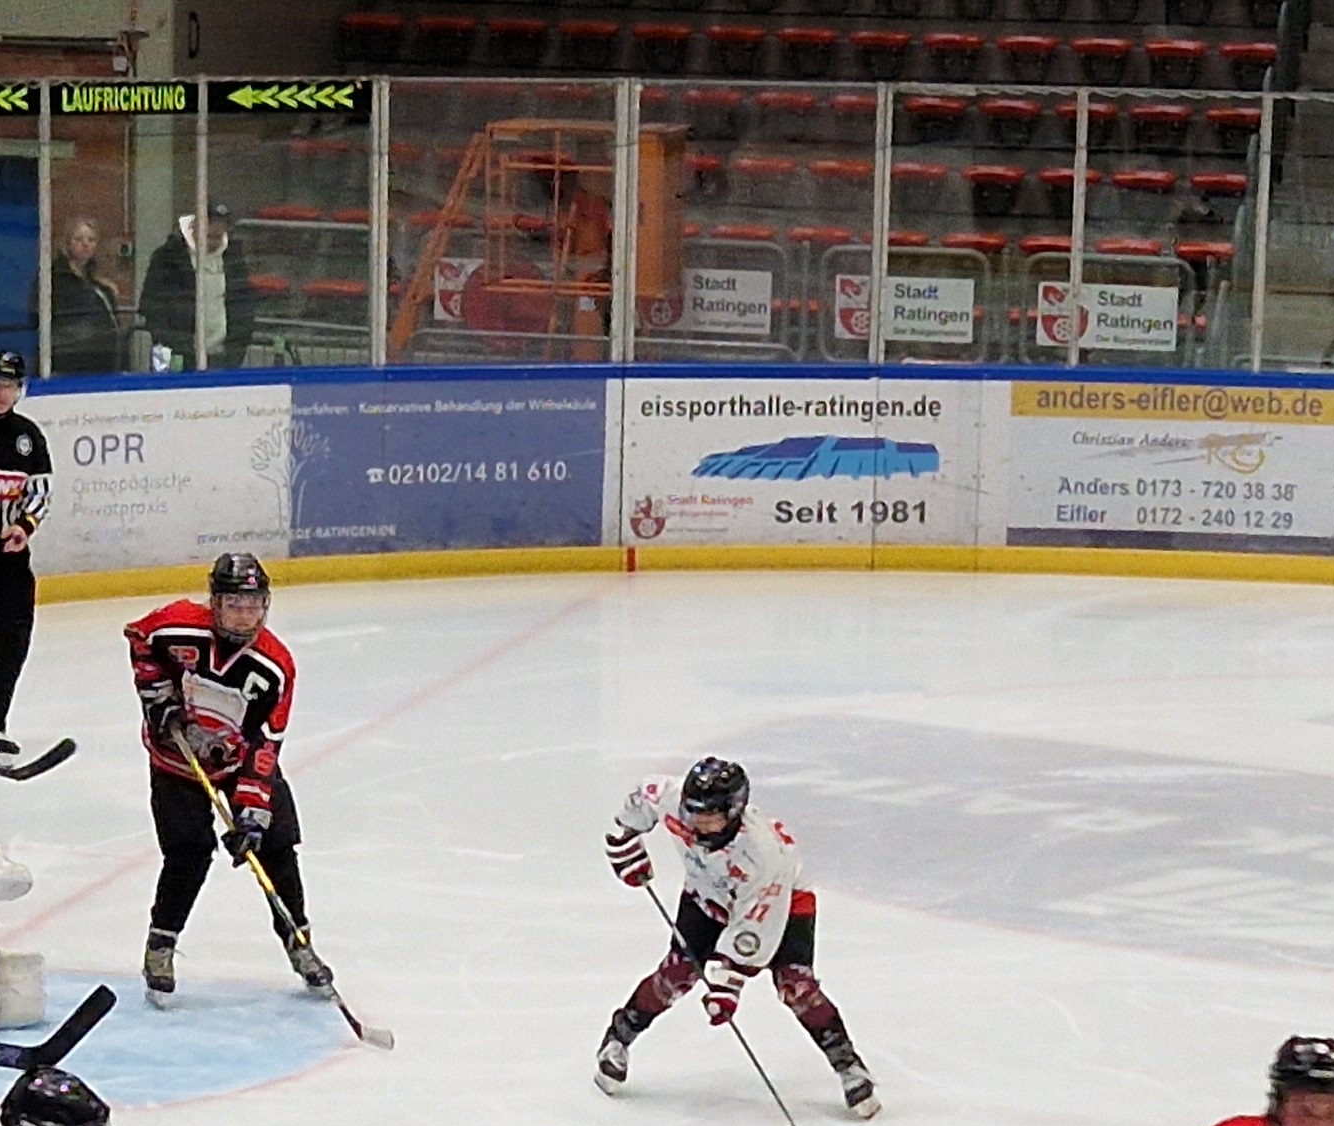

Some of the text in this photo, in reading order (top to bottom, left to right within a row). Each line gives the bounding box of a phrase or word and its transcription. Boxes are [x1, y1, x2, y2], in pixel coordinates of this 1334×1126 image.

[61, 85, 186, 113] LAUFRICHTUNG
[692, 274, 738, 291] Stadt
[893, 283, 938, 300] Stadt
[692, 297, 768, 317] Ratingen
[1097, 290, 1142, 308] Stadt
[893, 305, 970, 326] Ratingen
[1096, 312, 1173, 333] Ratingen
[640, 394, 942, 422] eissporthalle-ratingen.de
[1035, 386, 1324, 420] anders-eifler@web.de
[73, 432, 145, 467] OPR
[388, 460, 567, 485] 02102/14 81 610
[1058, 475, 1130, 497] Anders
[1135, 478, 1183, 498] 0173
[1202, 480, 1236, 500] 720
[1242, 481, 1265, 501] 38
[1271, 482, 1297, 502] 38
[774, 499, 928, 524] Seit 1981
[1055, 503, 1107, 524] Eifler
[1135, 507, 1183, 526] 0172
[1201, 508, 1235, 527] 240
[1244, 509, 1264, 528] 12
[1270, 510, 1294, 529] 29
